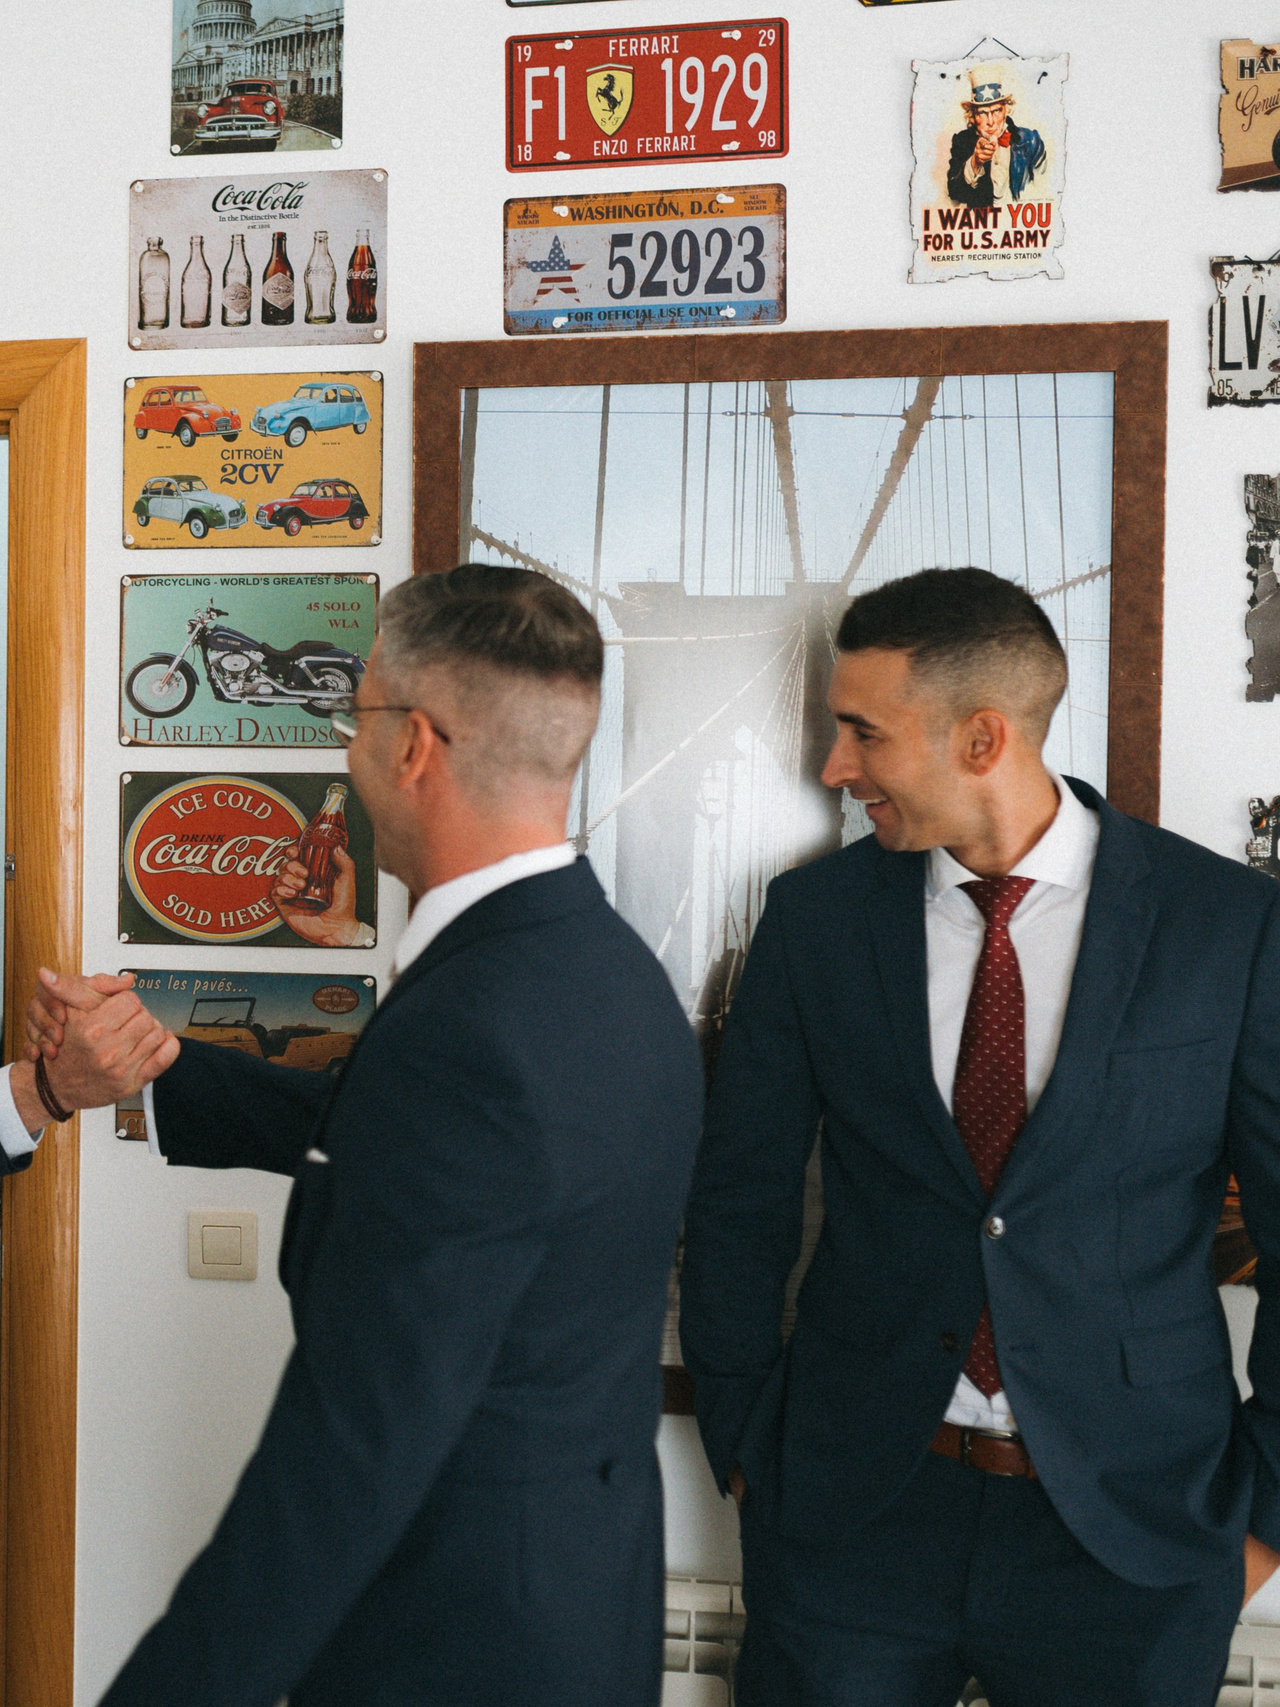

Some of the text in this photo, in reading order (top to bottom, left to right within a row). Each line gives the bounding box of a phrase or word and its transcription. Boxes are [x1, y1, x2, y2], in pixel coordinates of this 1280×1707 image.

[608, 35, 679, 58] FERRARI
[758, 29, 776, 47] 29
[517, 46, 532, 63] 19
[525, 52, 768, 142] F1 1929
[593, 135, 696, 157] ENZO FERRARI
[758, 130, 776, 148] 98
[517, 145, 532, 162] 18
[212, 181, 310, 213] Coca-Cola
[228, 214, 238, 222] the
[240, 213, 277, 221] Distinctive
[279, 212, 299, 220] Bottle
[570, 200, 724, 221] WASHINGTON, D.C.
[923, 202, 1051, 231] I WANT YOU
[923, 233, 954, 251] FOR
[607, 225, 766, 300] 52923
[931, 252, 1042, 262] NEAREST RECRUITING STATION
[567, 306, 724, 323] FOR OFFICIAL USE ONLY
[1219, 295, 1266, 371] LV
[1217, 379, 1233, 396] 05
[220, 446, 283, 460] CITROËN
[220, 463, 284, 485] 2CV
[220, 577, 270, 587] WORLD'S
[272, 576, 330, 586] GREATEST
[333, 575, 368, 586] SPOR
[306, 601, 361, 612] 45 SOLO
[328, 619, 360, 629] WLA
[169, 790, 273, 820] ICE COLD
[179, 833, 227, 843] DRINK
[139, 833, 299, 876] Coca-Cola
[162, 893, 276, 928] SOLD HERE
[167, 974, 187, 990] les
